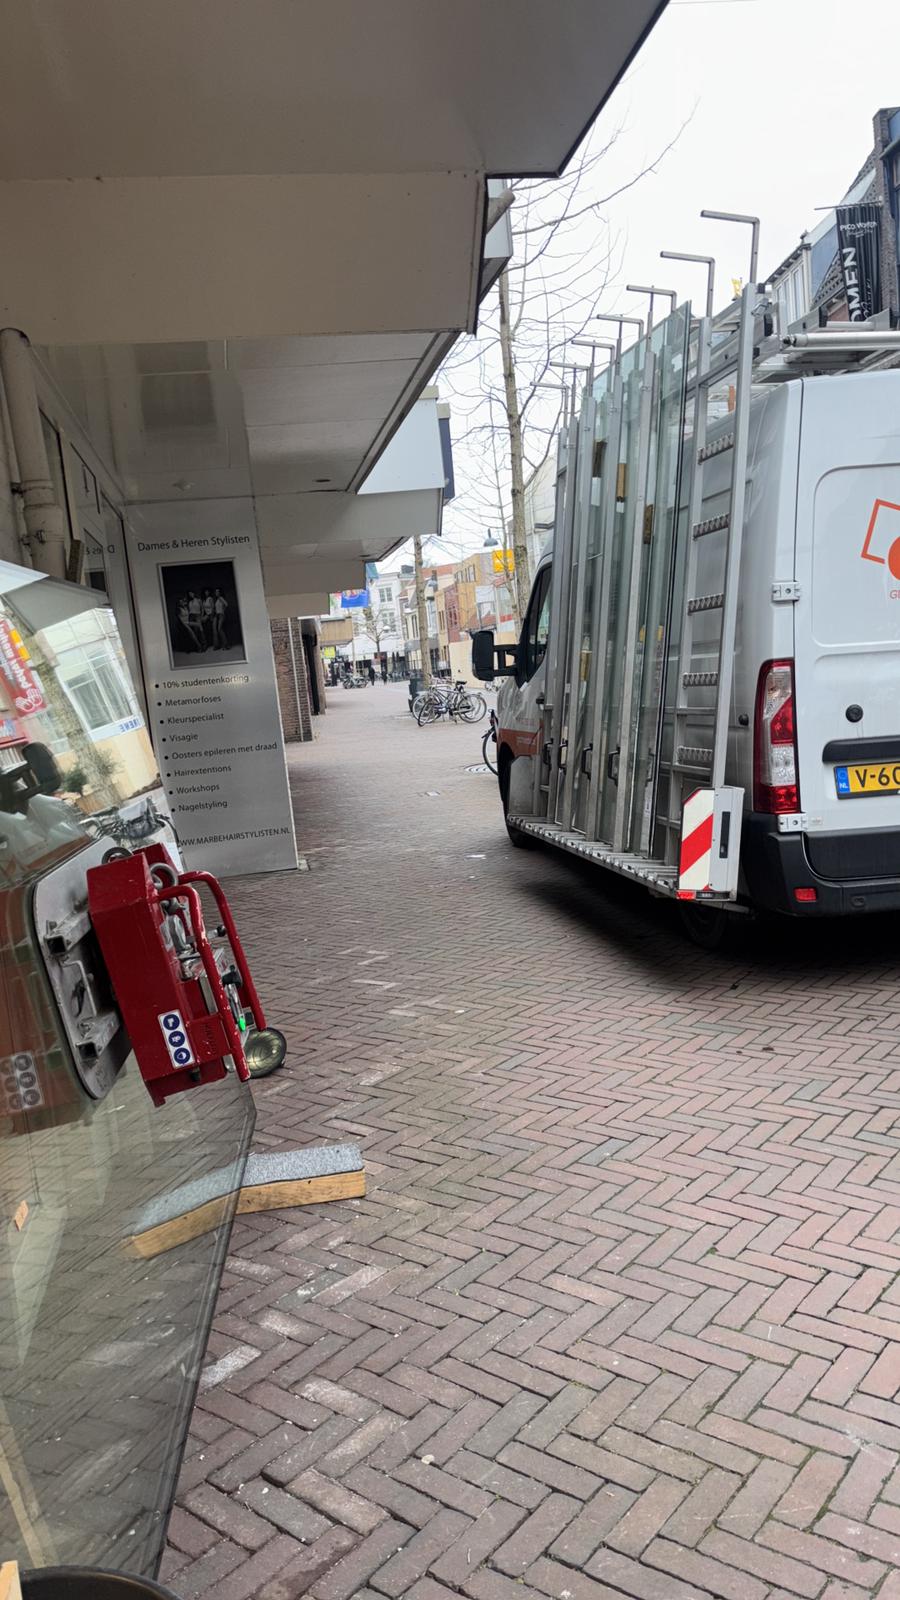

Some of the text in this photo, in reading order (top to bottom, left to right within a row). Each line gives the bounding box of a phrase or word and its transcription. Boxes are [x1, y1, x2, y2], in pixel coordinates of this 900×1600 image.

[137, 535, 251, 552] Dames & Heren Stylisten
[163, 675, 249, 689] 10% studentenkorting
[165, 695, 222, 706] Metamorfoses
[167, 713, 225, 725] Kleurspecialist
[169, 733, 199, 743] Visagie
[172, 742, 278, 760] Oosters epileren met draad
[174, 764, 232, 777] Hairextentions
[176, 783, 220, 795] Workshops
[178, 800, 228, 812] Nagelstyling
[178, 827, 291, 847] WW.MARBEHAIRSTYLISTEN.NL
